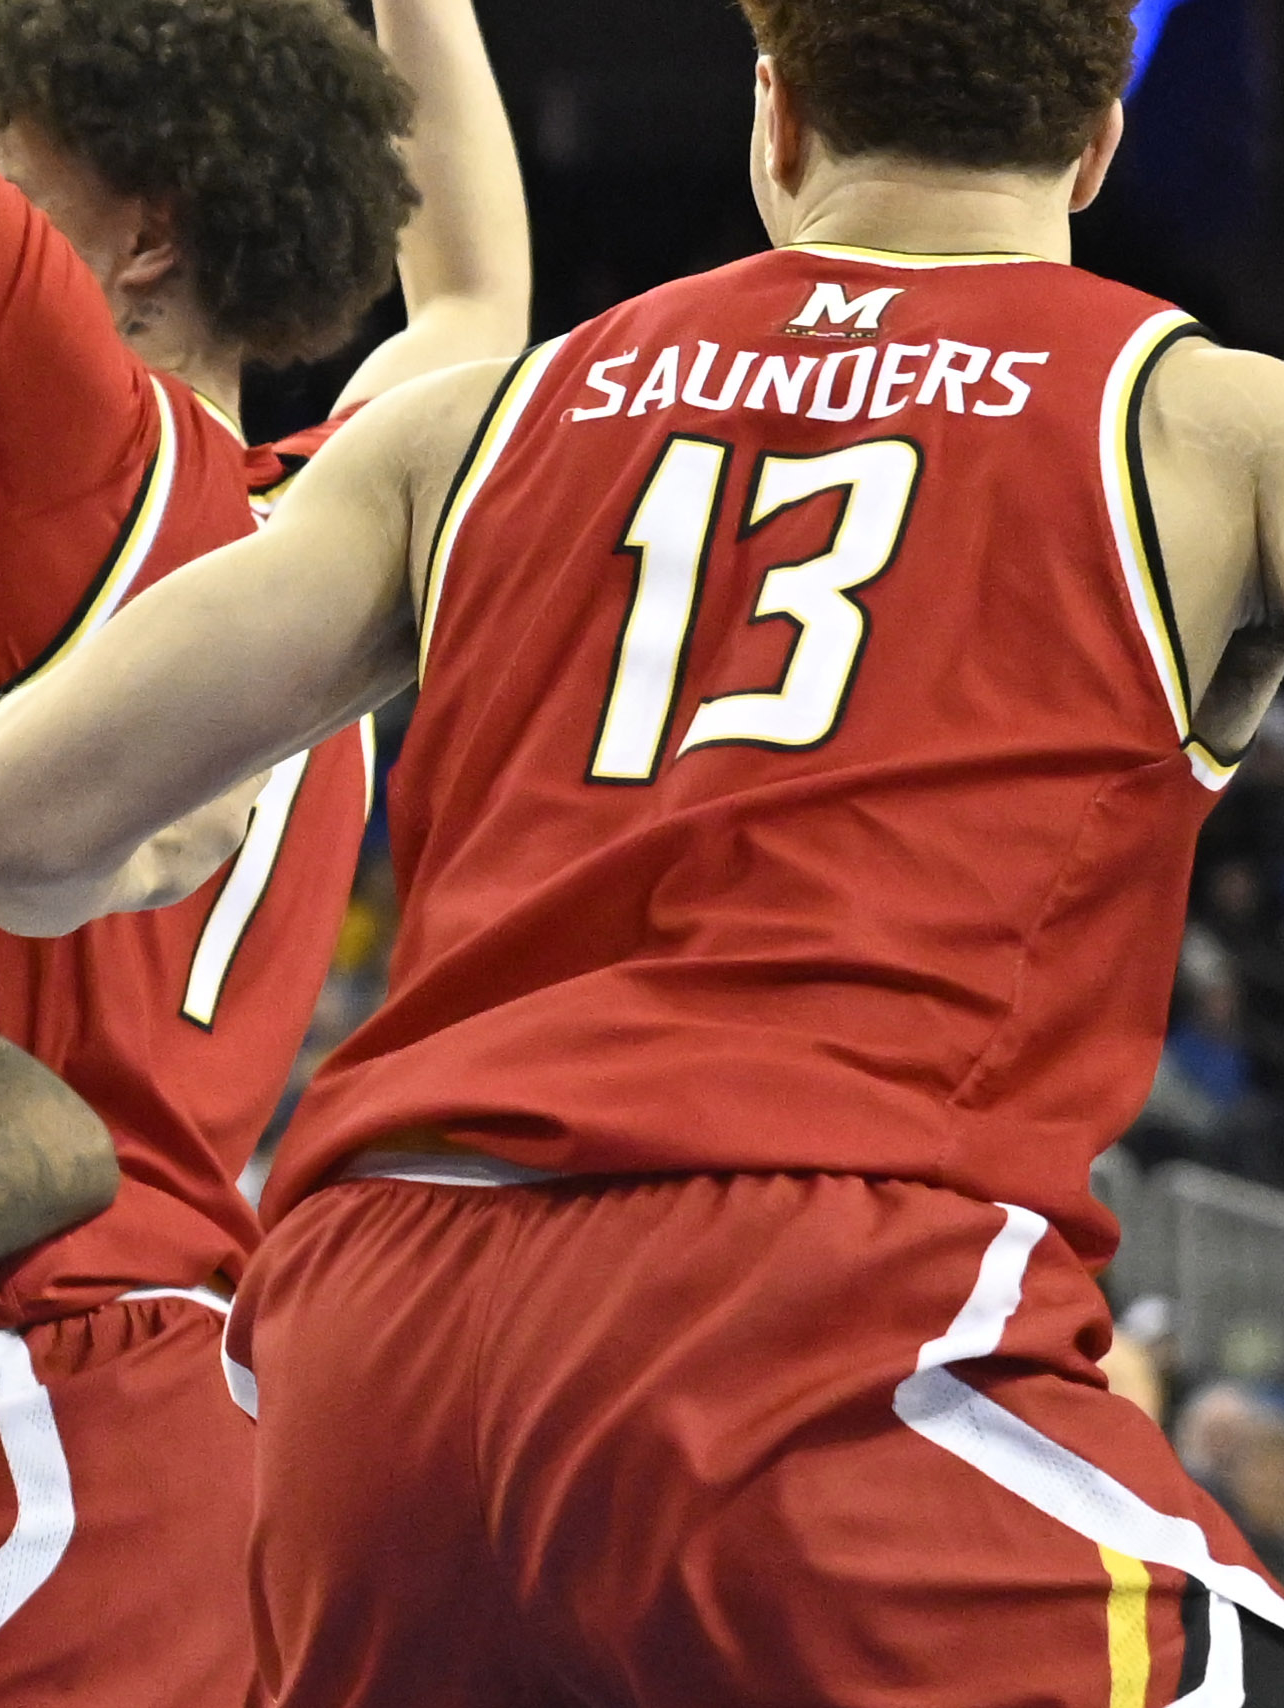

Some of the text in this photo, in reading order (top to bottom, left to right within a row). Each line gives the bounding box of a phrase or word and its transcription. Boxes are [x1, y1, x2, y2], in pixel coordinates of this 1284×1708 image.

[786, 281, 907, 330] M
[562, 338, 1051, 423] SAUNDERS
[584, 431, 925, 786] 13
